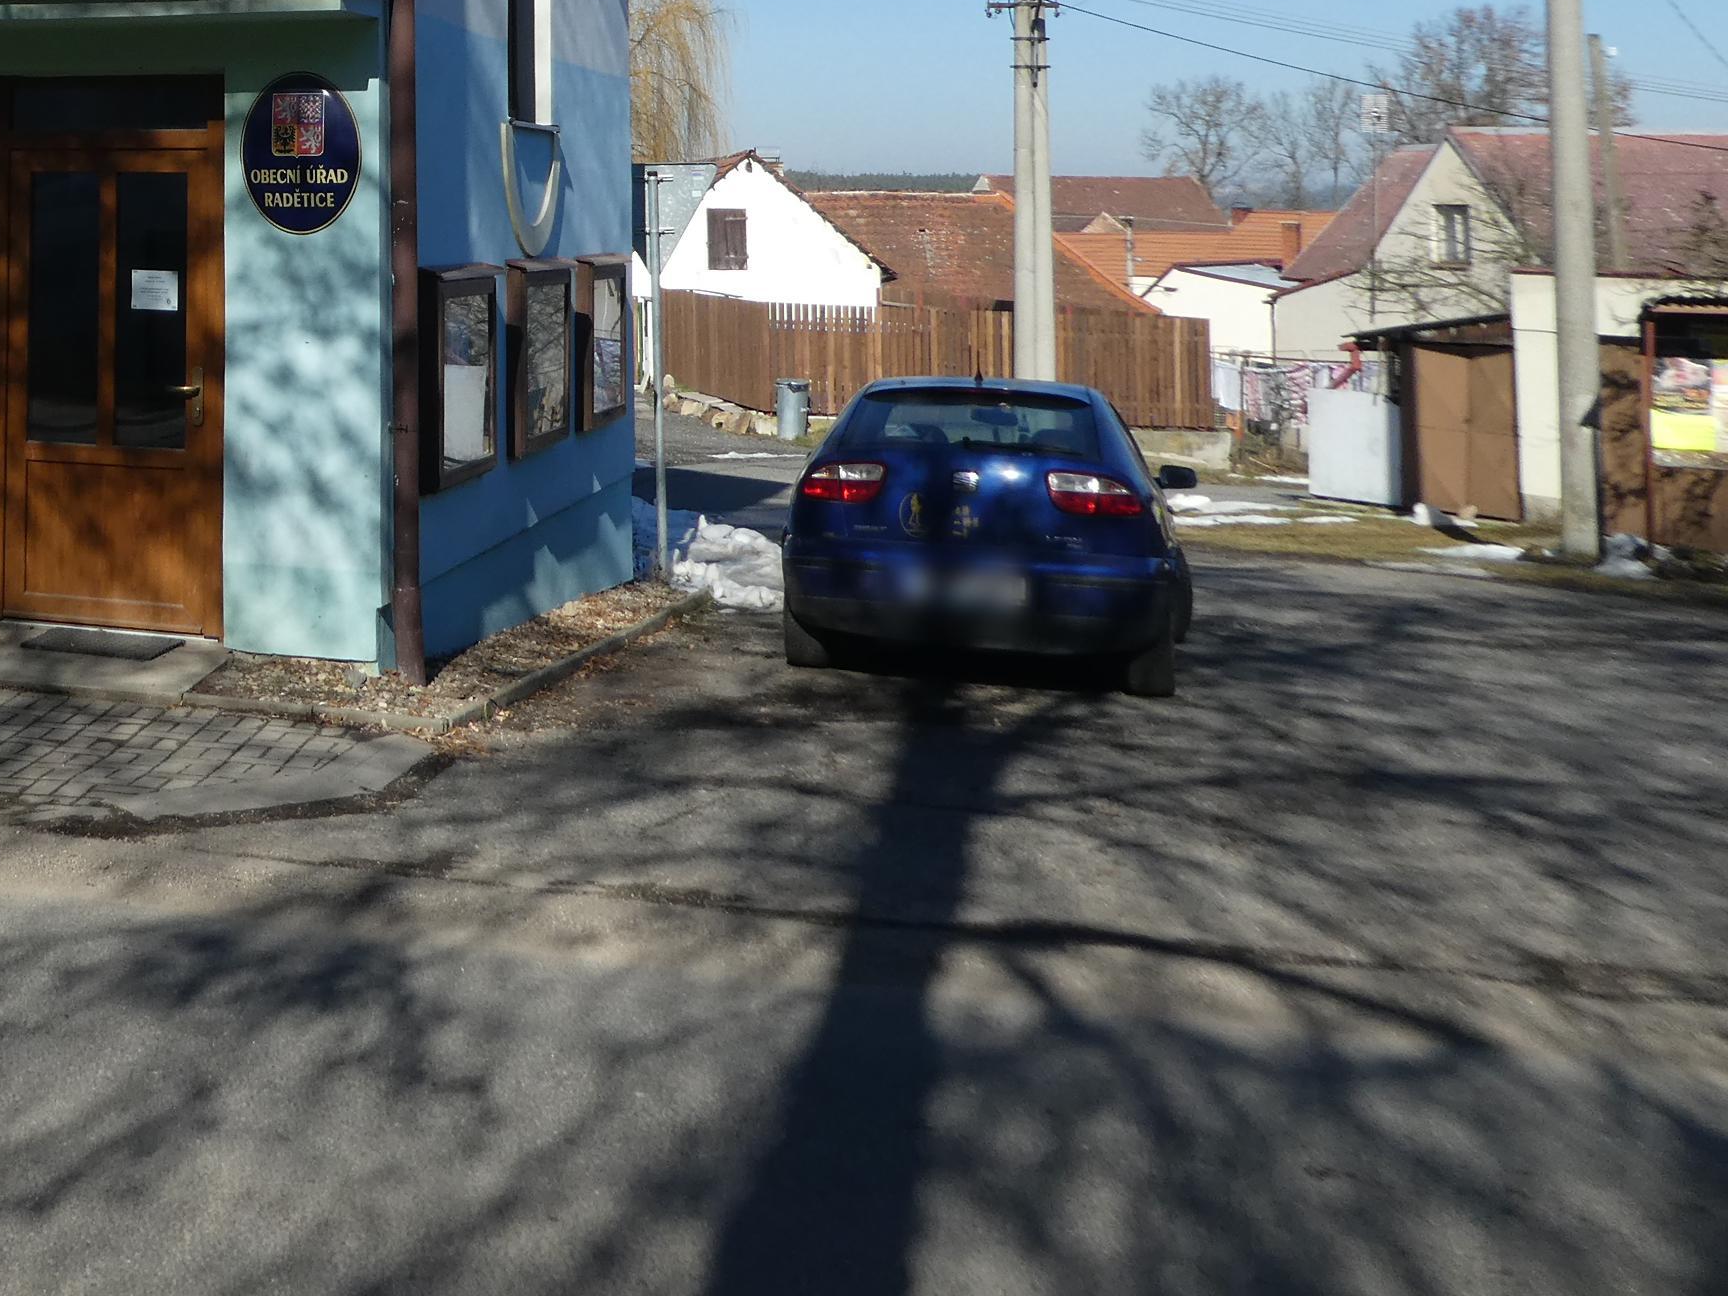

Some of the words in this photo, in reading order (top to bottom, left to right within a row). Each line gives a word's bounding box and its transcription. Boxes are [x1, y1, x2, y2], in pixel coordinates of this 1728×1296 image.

[250, 164, 301, 184] OBECNÍ
[306, 164, 349, 184] ÚŘAD
[264, 188, 335, 208] RADĚTICE
